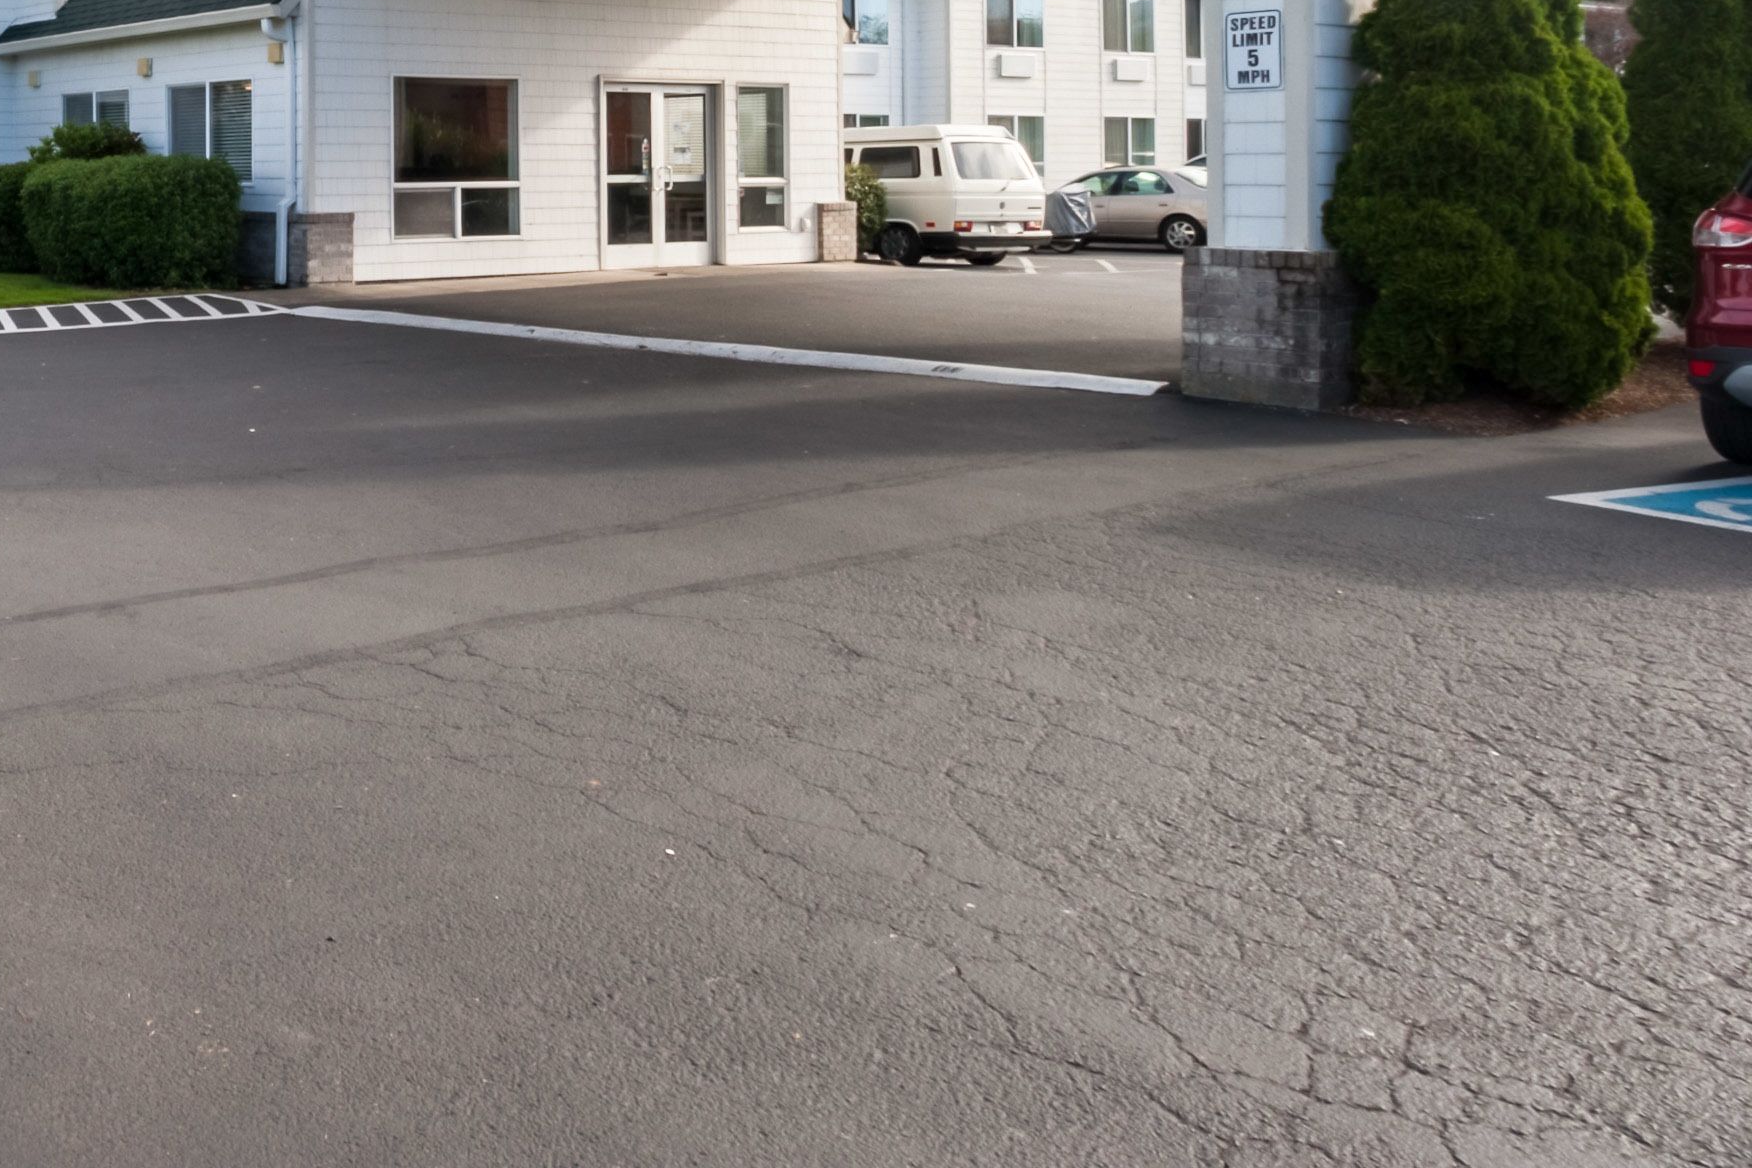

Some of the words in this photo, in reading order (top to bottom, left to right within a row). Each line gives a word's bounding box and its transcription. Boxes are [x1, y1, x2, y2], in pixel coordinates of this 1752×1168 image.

[1230, 15, 1277, 31] SPEED
[1232, 32, 1273, 47] LIMIT
[1247, 49, 1259, 67] 5
[1237, 70, 1270, 84] MPH
